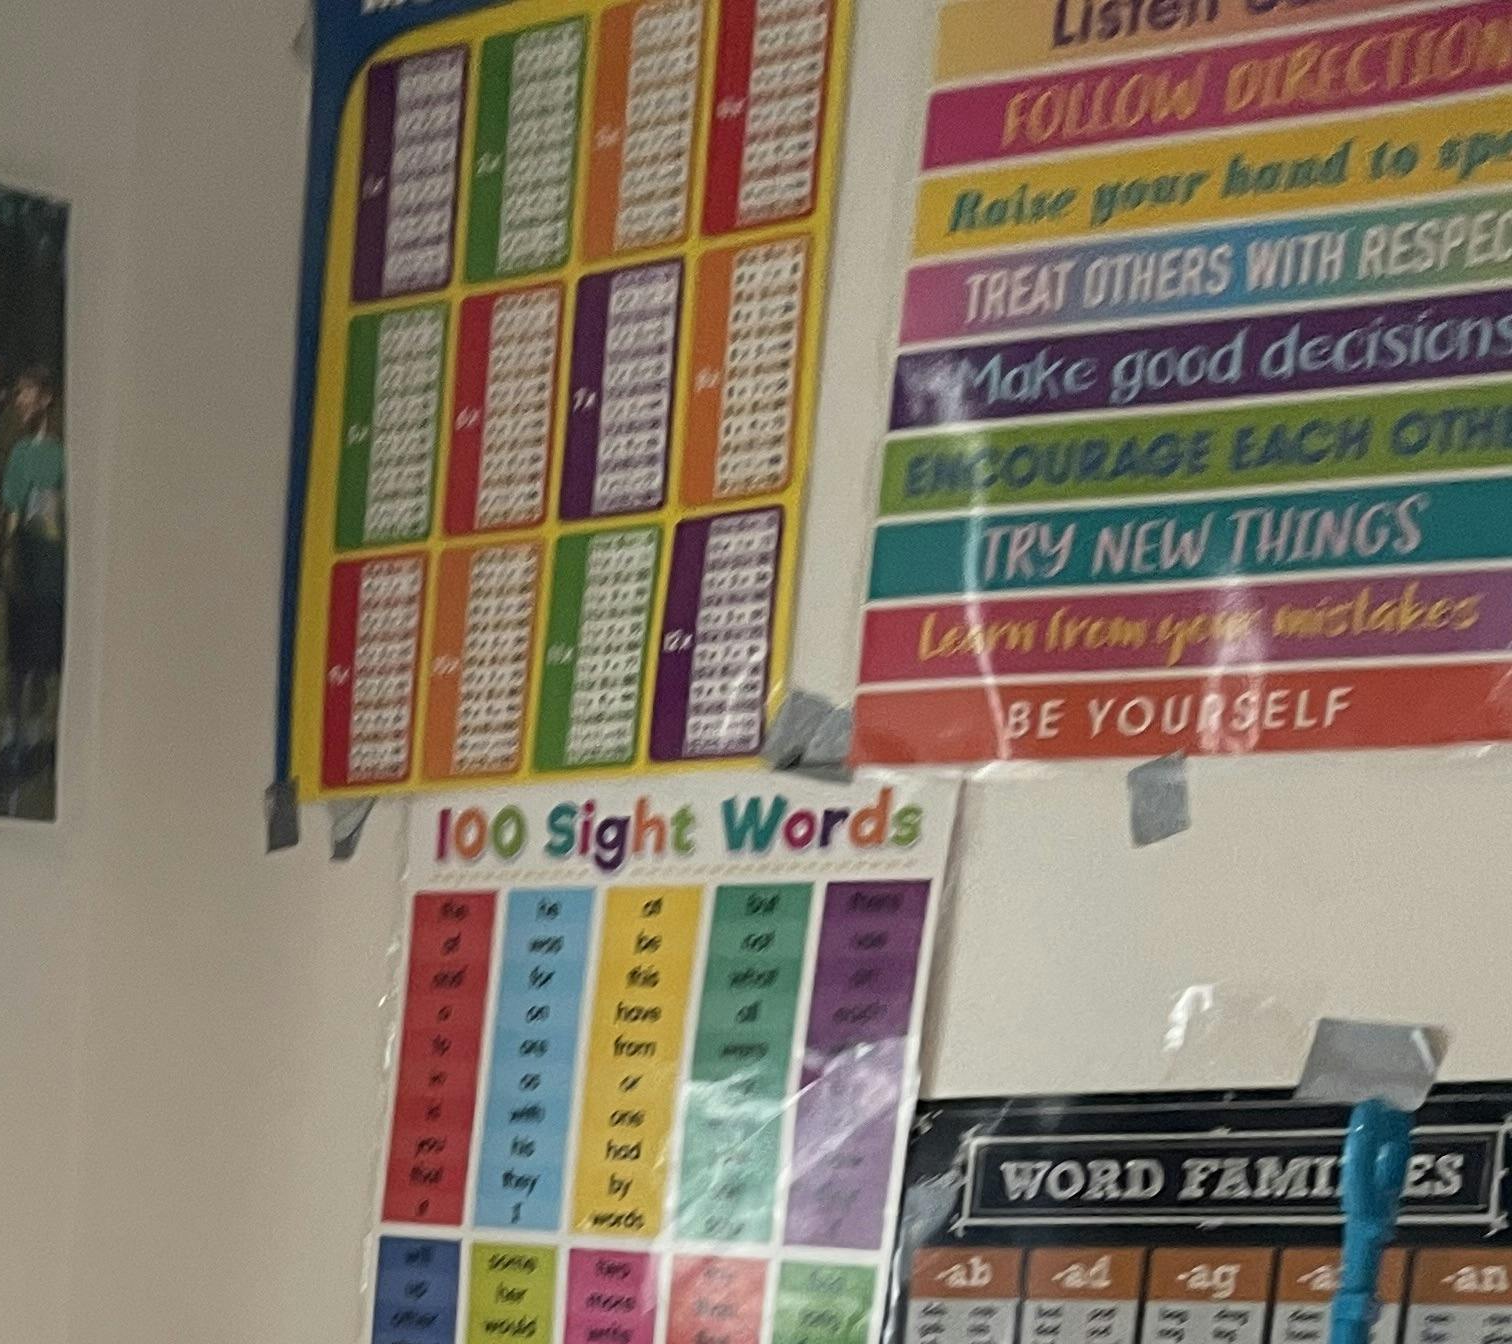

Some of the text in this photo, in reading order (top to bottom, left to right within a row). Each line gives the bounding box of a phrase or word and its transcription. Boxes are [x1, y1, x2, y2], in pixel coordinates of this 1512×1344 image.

[999, 59, 1210, 150] FOLLOW
[948, 184, 1077, 236] Raise
[1090, 168, 1210, 228] your
[1219, 136, 1356, 198] hand
[1365, 140, 1420, 181] to
[963, 257, 1078, 323] TREAT
[1082, 241, 1234, 311] OTHERS
[1245, 228, 1348, 290] WITH
[961, 346, 1099, 406] Make
[1110, 325, 1251, 406] good
[903, 425, 1216, 499] ENCOURAGE
[1227, 414, 1375, 473] EACH
[980, 491, 1432, 583] TRY NEW THINGS
[916, 609, 1037, 664] Learn
[1042, 603, 1148, 653] from
[1269, 579, 1486, 640] mistakes
[1005, 684, 1356, 742] BE YOURSELF
[435, 785, 926, 874] 100 Sight Words
[615, 1001, 662, 1023] have
[613, 1035, 656, 1058] from
[609, 1110, 645, 1127] one
[605, 1140, 643, 1162] had
[607, 1173, 633, 1199] by
[999, 1152, 1467, 1202] WORD FAMIES
[935, 1254, 994, 1293] -ab
[1051, 1255, 1114, 1292] -ad
[1175, 1261, 1242, 1302] -ag
[1296, 1261, 1343, 1292] -a
[1440, 1263, 1510, 1295] -an
